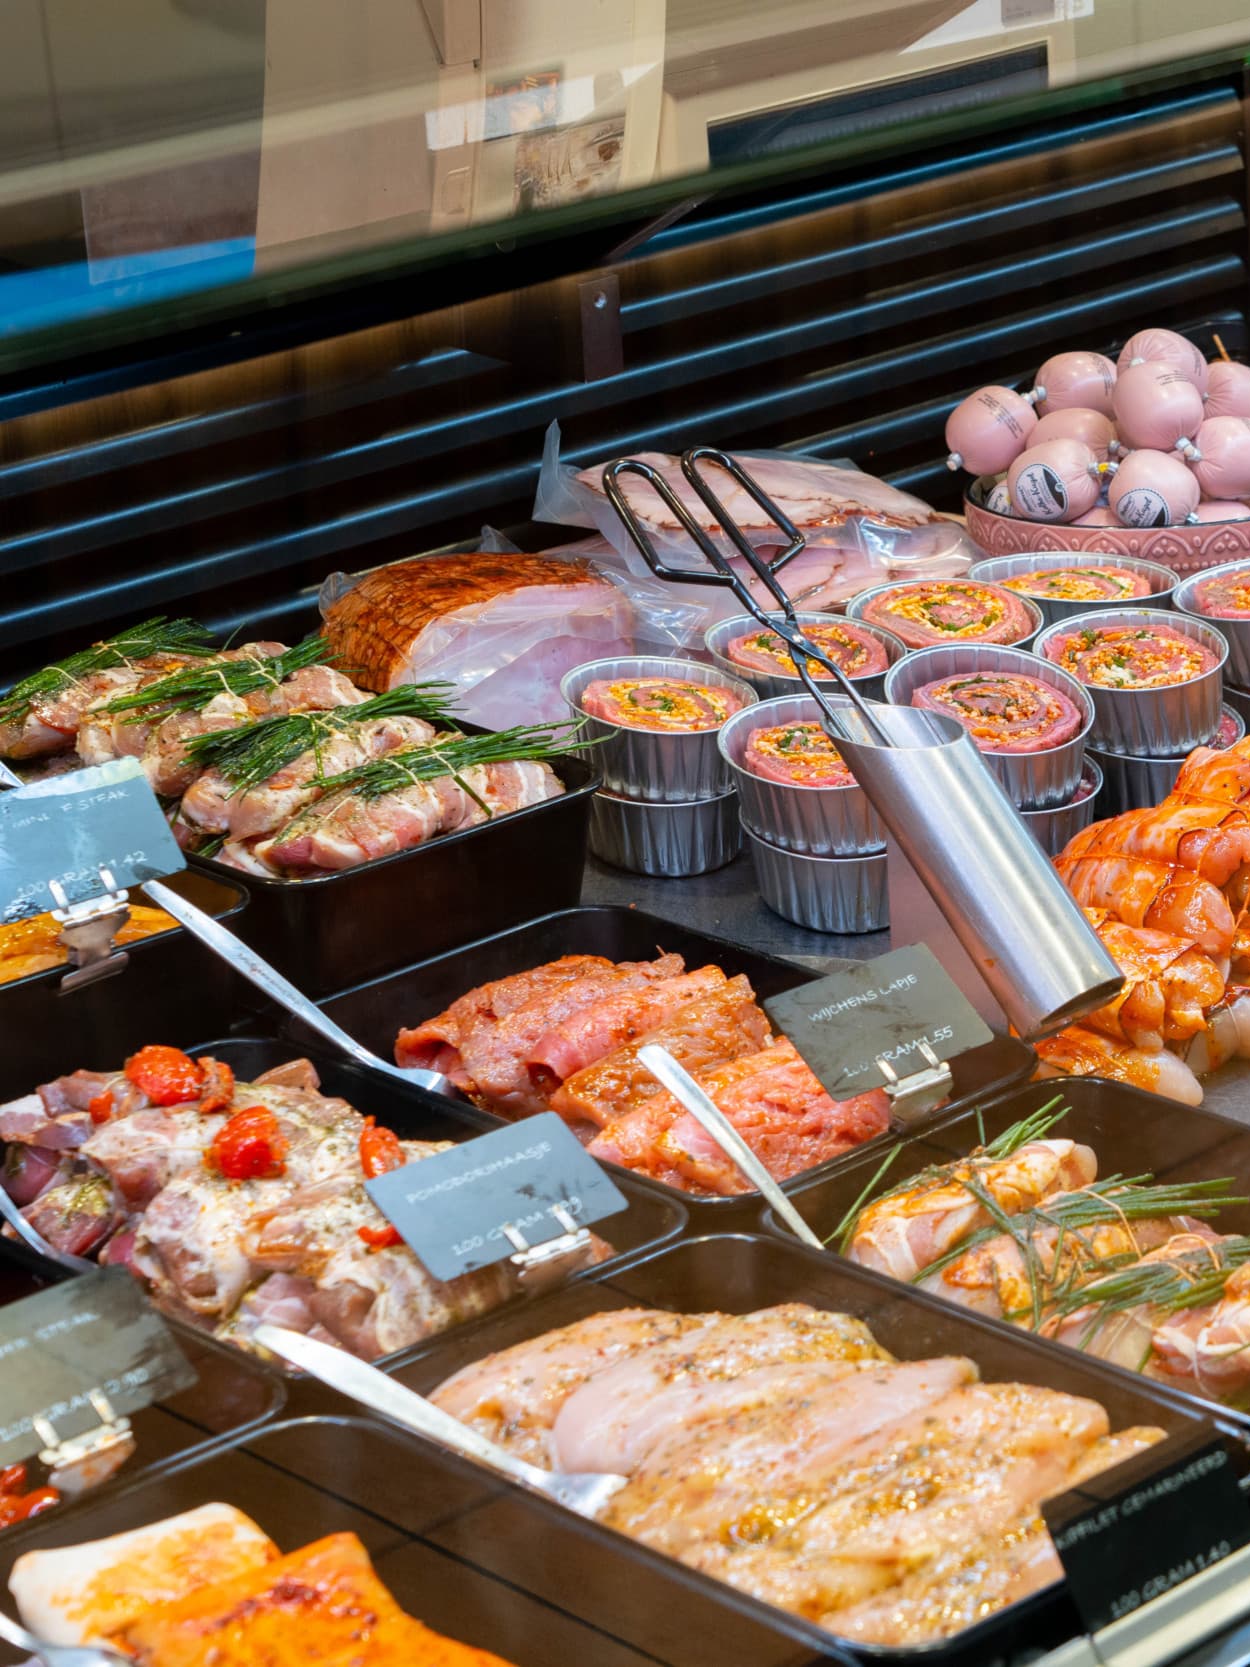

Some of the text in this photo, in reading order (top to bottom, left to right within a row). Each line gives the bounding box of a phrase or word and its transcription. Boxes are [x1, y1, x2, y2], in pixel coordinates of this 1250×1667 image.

[807, 990, 878, 1022] WIJCHENS
[873, 1039, 921, 1066] RAM
[451, 1235, 484, 1256] 100
[486, 1210, 544, 1241] GAM
[1110, 1588, 1141, 1617] 100
[1141, 1558, 1197, 1601] GRAM
